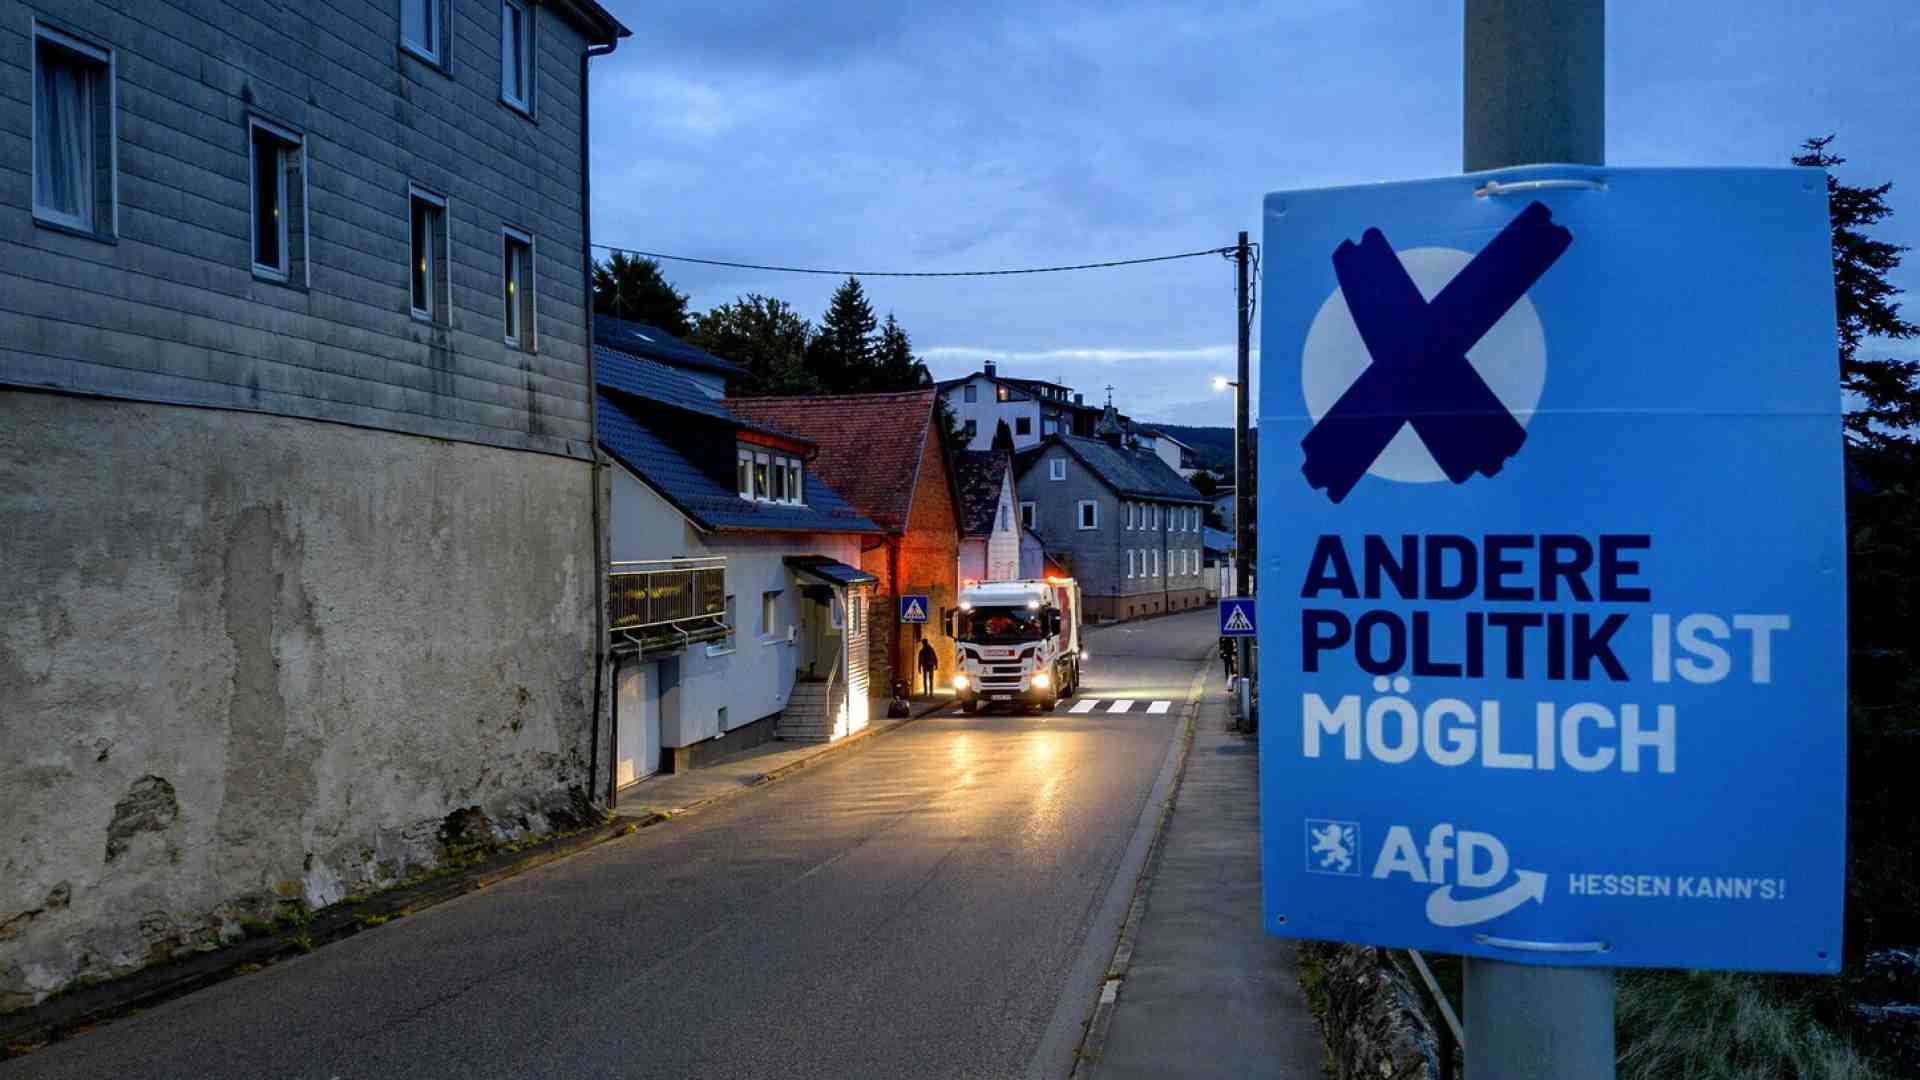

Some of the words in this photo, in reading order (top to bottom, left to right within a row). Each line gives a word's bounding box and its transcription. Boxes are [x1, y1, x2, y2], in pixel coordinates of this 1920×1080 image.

[1301, 534, 1651, 602] ANDERE
[1302, 609, 1630, 681] POLITIK
[1651, 614, 1790, 683] IST
[1302, 675, 1677, 773] MÖGLICH
[1372, 823, 1509, 888] AfD
[1569, 873, 1671, 898] HESSEN
